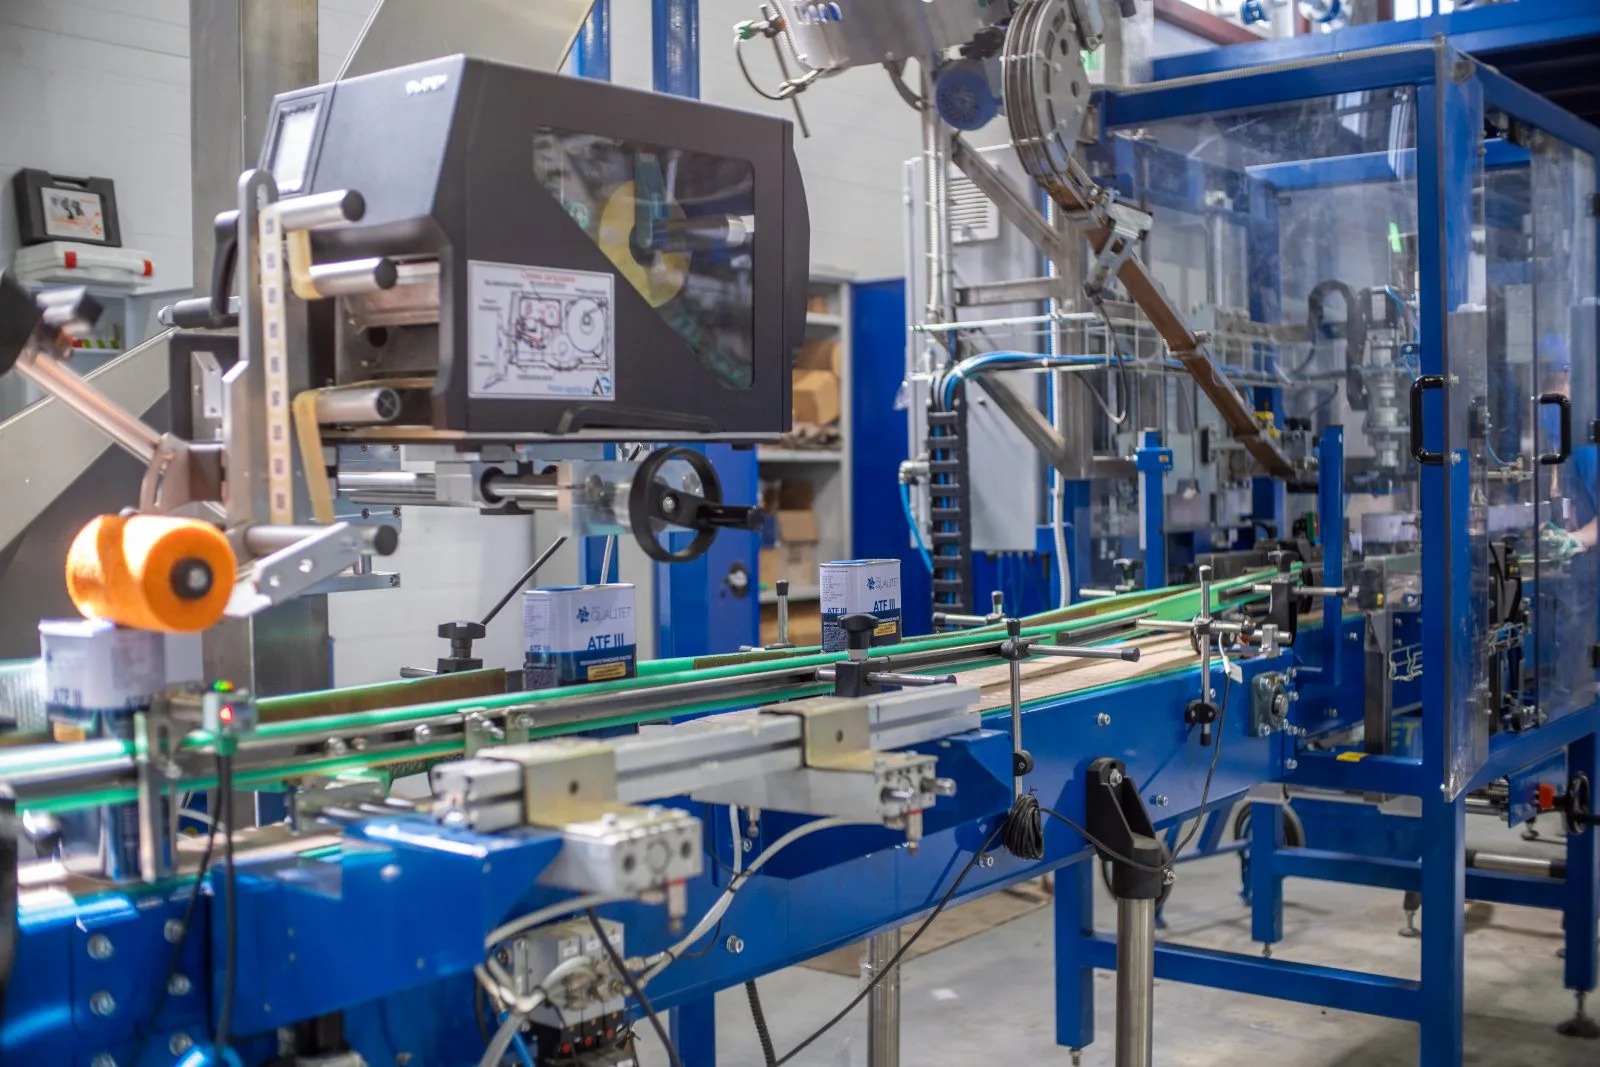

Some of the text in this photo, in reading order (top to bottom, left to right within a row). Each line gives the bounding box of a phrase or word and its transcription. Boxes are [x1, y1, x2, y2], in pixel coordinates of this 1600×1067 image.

[591, 606, 631, 623] QUALITET
[874, 600, 888, 612] ATF
[588, 632, 624, 650] ATF III
